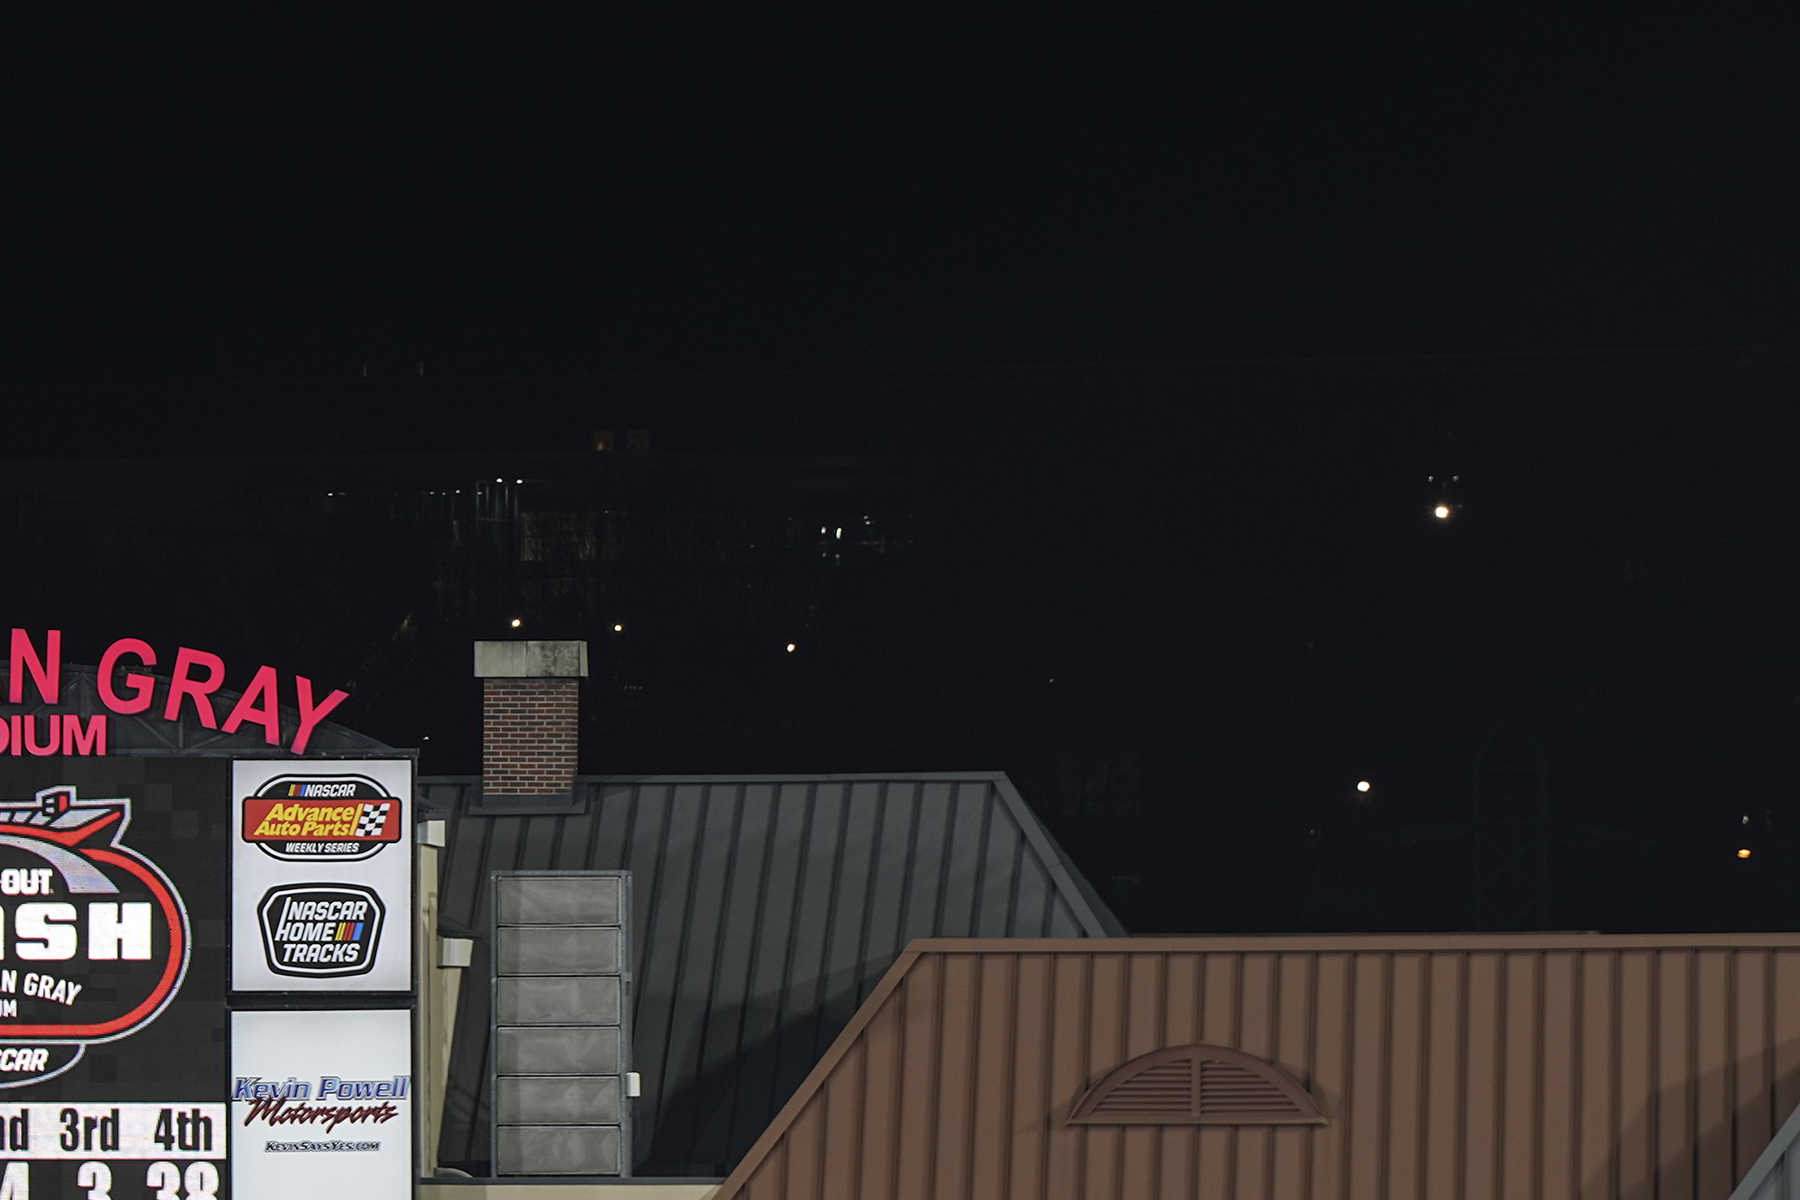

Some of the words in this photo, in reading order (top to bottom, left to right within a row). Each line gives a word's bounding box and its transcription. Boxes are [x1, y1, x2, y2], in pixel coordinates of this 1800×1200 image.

[97, 637, 349, 755] GRAY
[304, 784, 356, 797] NASCAR
[265, 803, 354, 821] Advance
[253, 821, 299, 836] Auto
[300, 821, 350, 836] Parts
[285, 842, 324, 853] WEEKLY
[324, 842, 360, 853] SERIES
[0, 868, 52, 895] OUT
[274, 897, 337, 941] HOME
[287, 900, 368, 921] NASCAR
[283, 943, 361, 962] TRACKS
[23, 973, 83, 1006] GRAY
[233, 1077, 312, 1101] Kevin
[316, 1076, 411, 1101] Powell
[244, 1096, 399, 1134] Motorsports
[59, 1108, 120, 1151] 3rd
[154, 1108, 214, 1151] 4th
